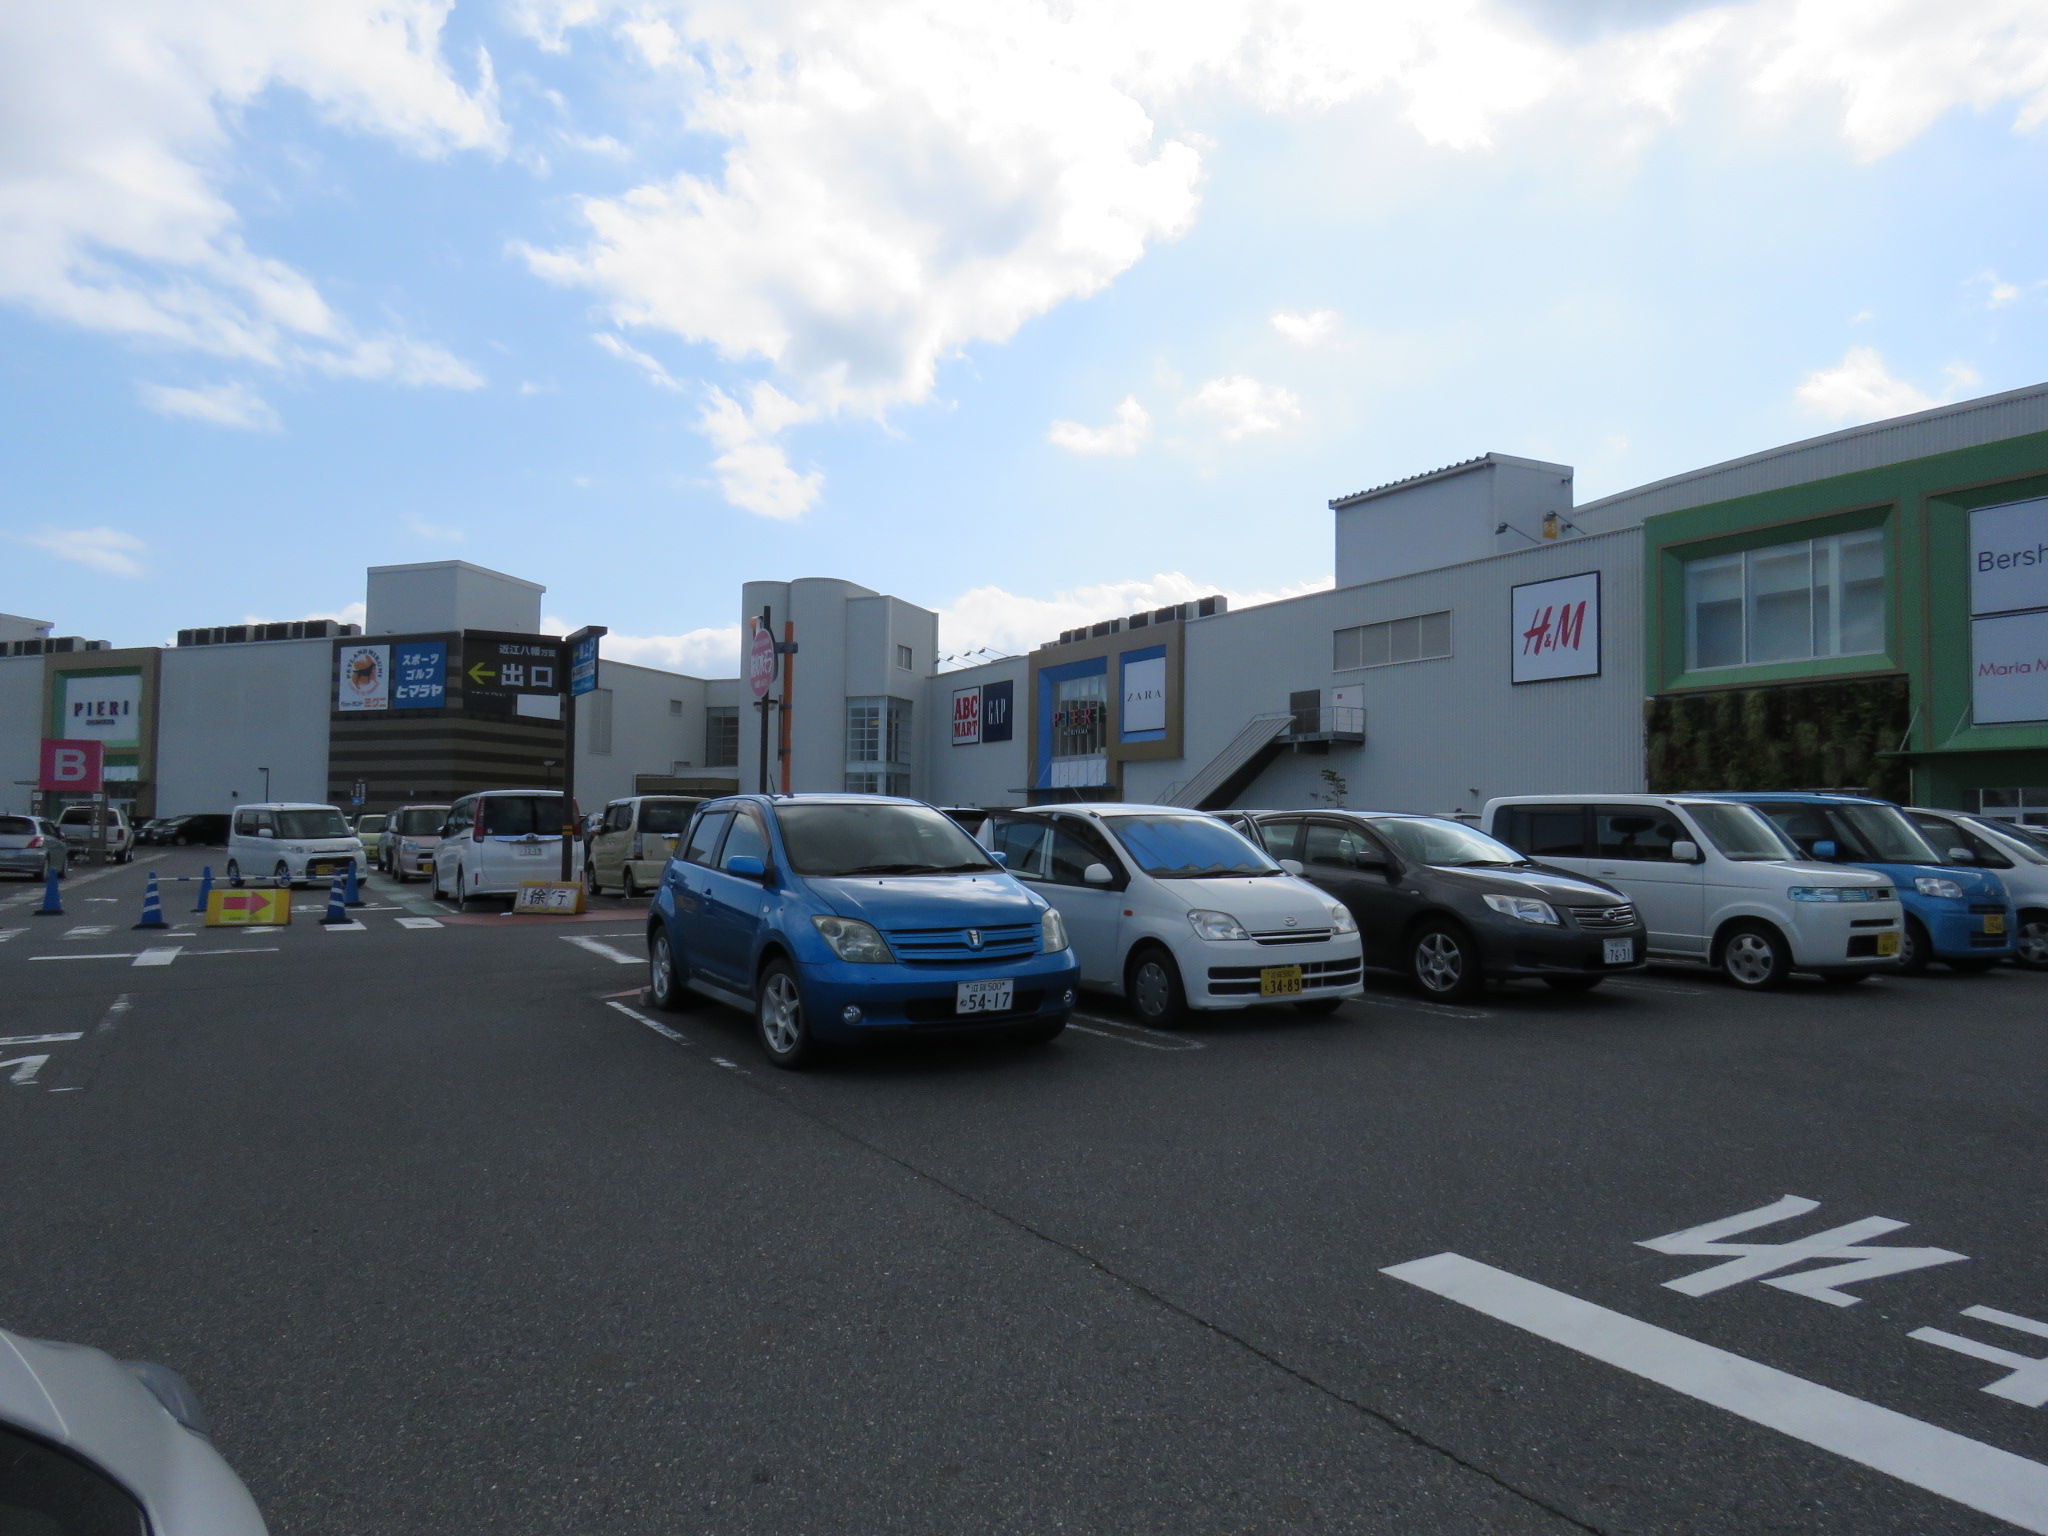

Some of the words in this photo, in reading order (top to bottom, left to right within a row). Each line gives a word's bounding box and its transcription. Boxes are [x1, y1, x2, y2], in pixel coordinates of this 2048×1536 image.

[1523, 601, 1586, 656] H&M
[402, 654, 440, 666] スポーツ
[405, 668, 435, 681] ゴルフ
[501, 663, 553, 687] 出口
[1978, 661, 2031, 677] Maria
[396, 684, 443, 699] ヒマラヤ
[1127, 689, 1162, 702] ZARA
[74, 700, 129, 717] PIERI
[954, 695, 978, 720] ABC
[988, 698, 1006, 725] GAP
[953, 720, 978, 738] MART
[54, 749, 87, 781] B
[530, 889, 567, 906] 徐行
[1270, 978, 1301, 994] 34-89
[968, 991, 1011, 1011] 54-17
